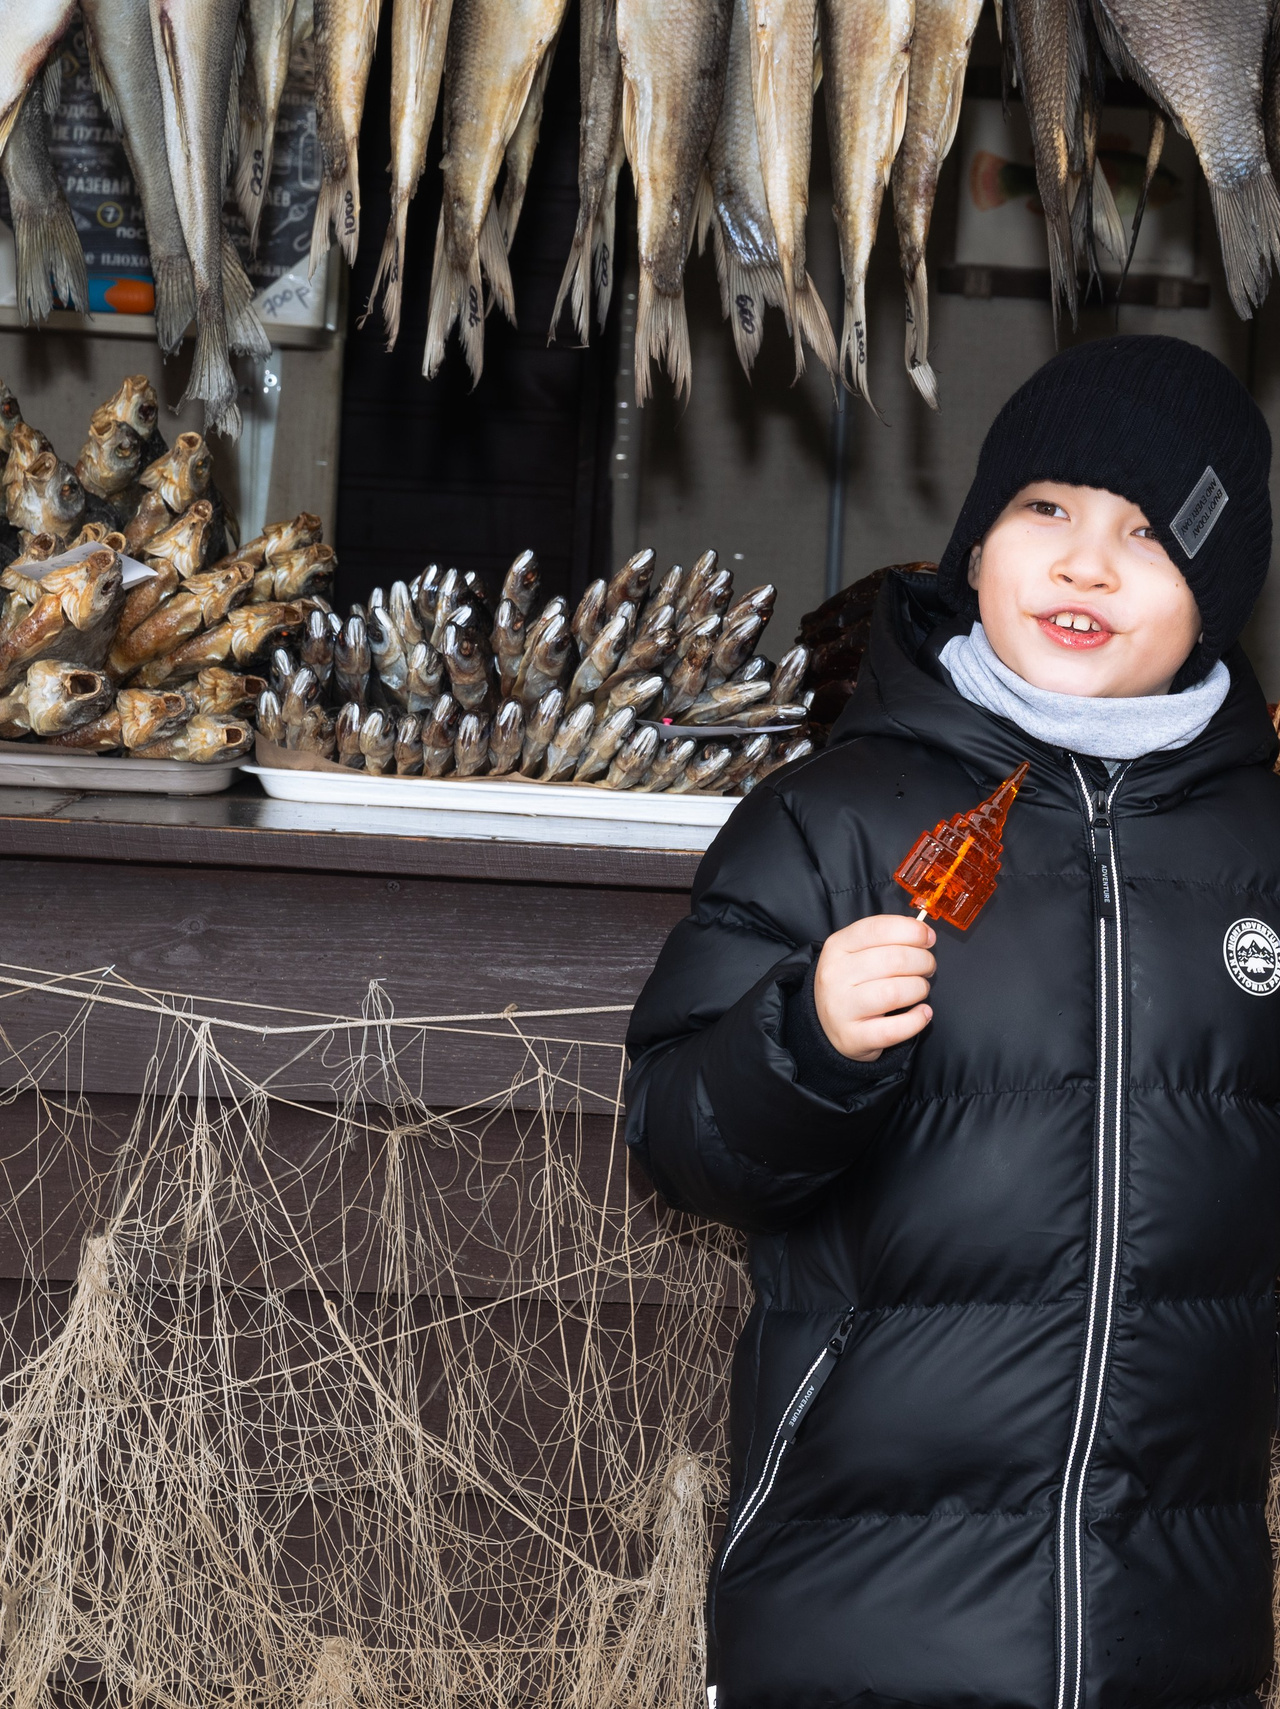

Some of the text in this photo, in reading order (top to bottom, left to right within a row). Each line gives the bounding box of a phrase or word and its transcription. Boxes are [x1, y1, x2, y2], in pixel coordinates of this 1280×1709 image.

[344, 190, 356, 236] 1000
[1180, 477, 1217, 536] AND EVERY DAY
[1191, 488, 1223, 539] ENJOY TODAY
[1100, 863, 1111, 904] ADVENTURE
[1229, 959, 1270, 992] NATIONAL
[788, 1384, 816, 1428] ADVENTURE
